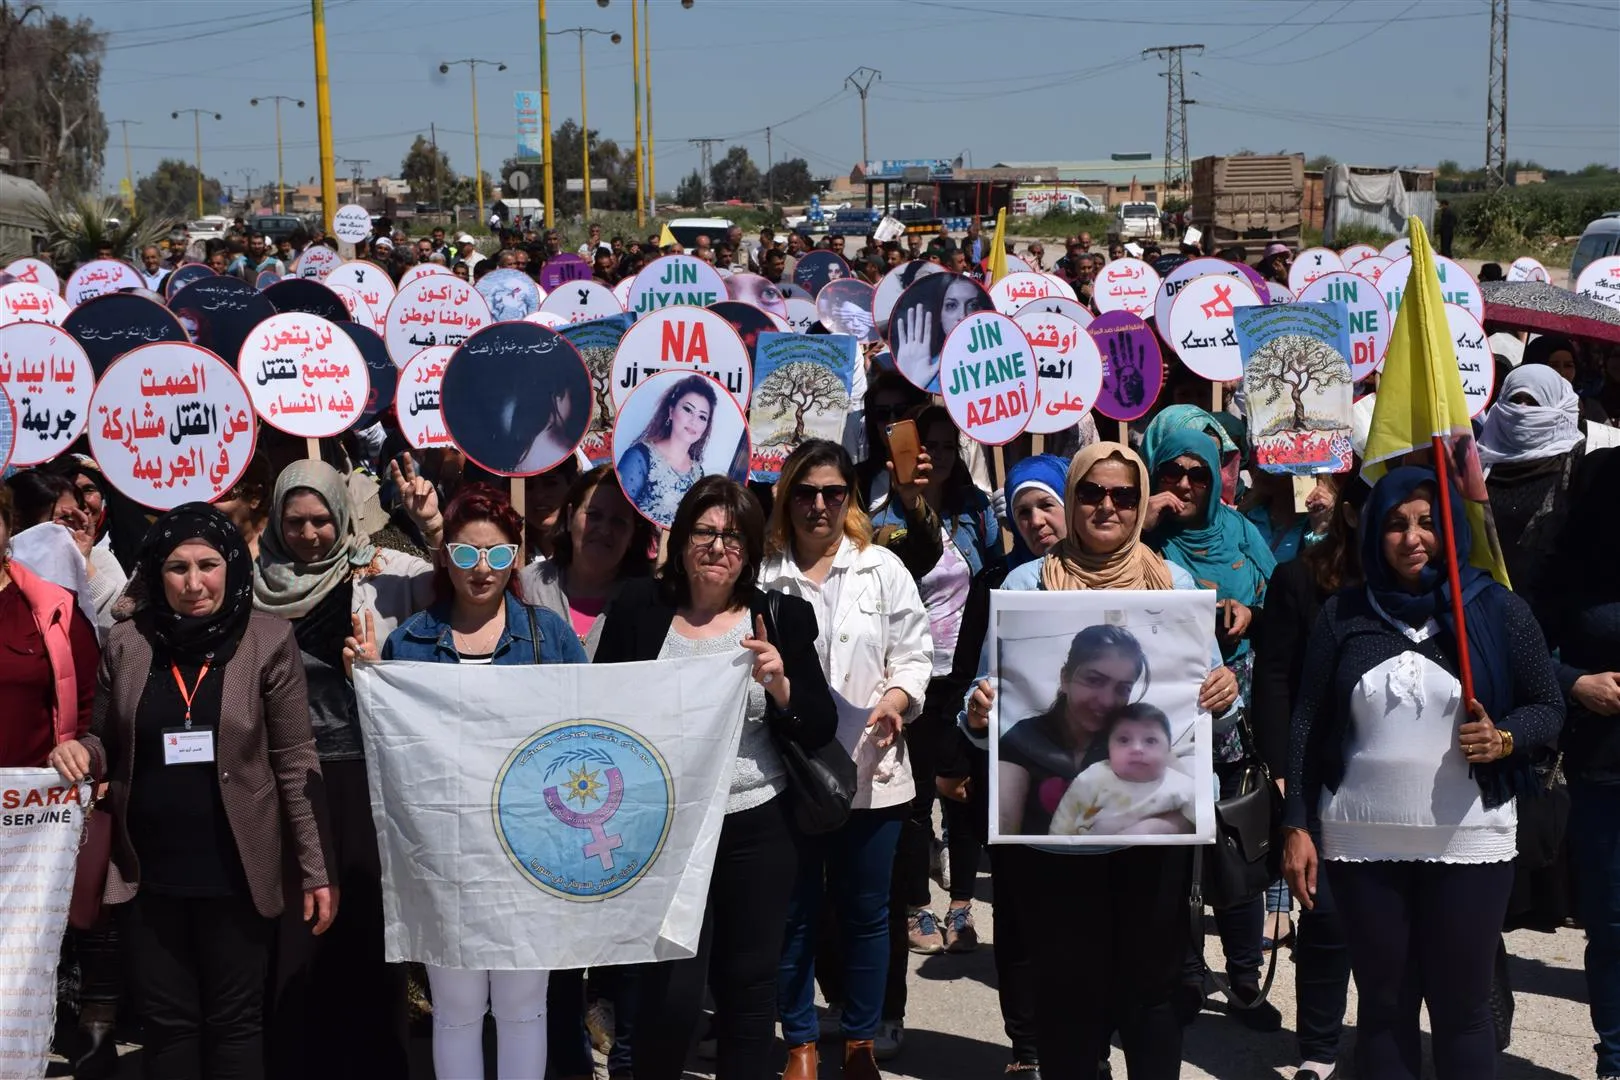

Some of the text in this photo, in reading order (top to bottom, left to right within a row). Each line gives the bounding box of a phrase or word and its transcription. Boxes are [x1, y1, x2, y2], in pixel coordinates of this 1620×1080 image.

[661, 259, 697, 285] JİN
[1314, 254, 1322, 265] لا
[355, 270, 365, 283] لا
[1107, 265, 1145, 283] ارفع
[5, 291, 55, 315] أوقفوا
[418, 284, 470, 305] لن أكون
[578, 289, 590, 305] لا
[1109, 286, 1148, 299] يدك
[1322, 277, 1358, 303] JİN
[315, 325, 333, 350] لن
[661, 319, 710, 364] NA
[967, 318, 1003, 353] JİN
[140, 360, 206, 397] الصمت
[256, 358, 298, 386] تقتل
[727, 367, 743, 393] Lİ
[949, 351, 1027, 395] JİYANE
[1038, 356, 1073, 380] العن
[269, 390, 355, 419] فيه النساء
[966, 382, 1029, 428] AZADÎ
[1045, 390, 1084, 416] على
[22, 397, 77, 441] جريمة
[98, 401, 249, 449] عن القتل مشاركة
[129, 440, 230, 492] في الجريمة
[2, 783, 82, 810] SARA
[3, 813, 35, 826] SER
